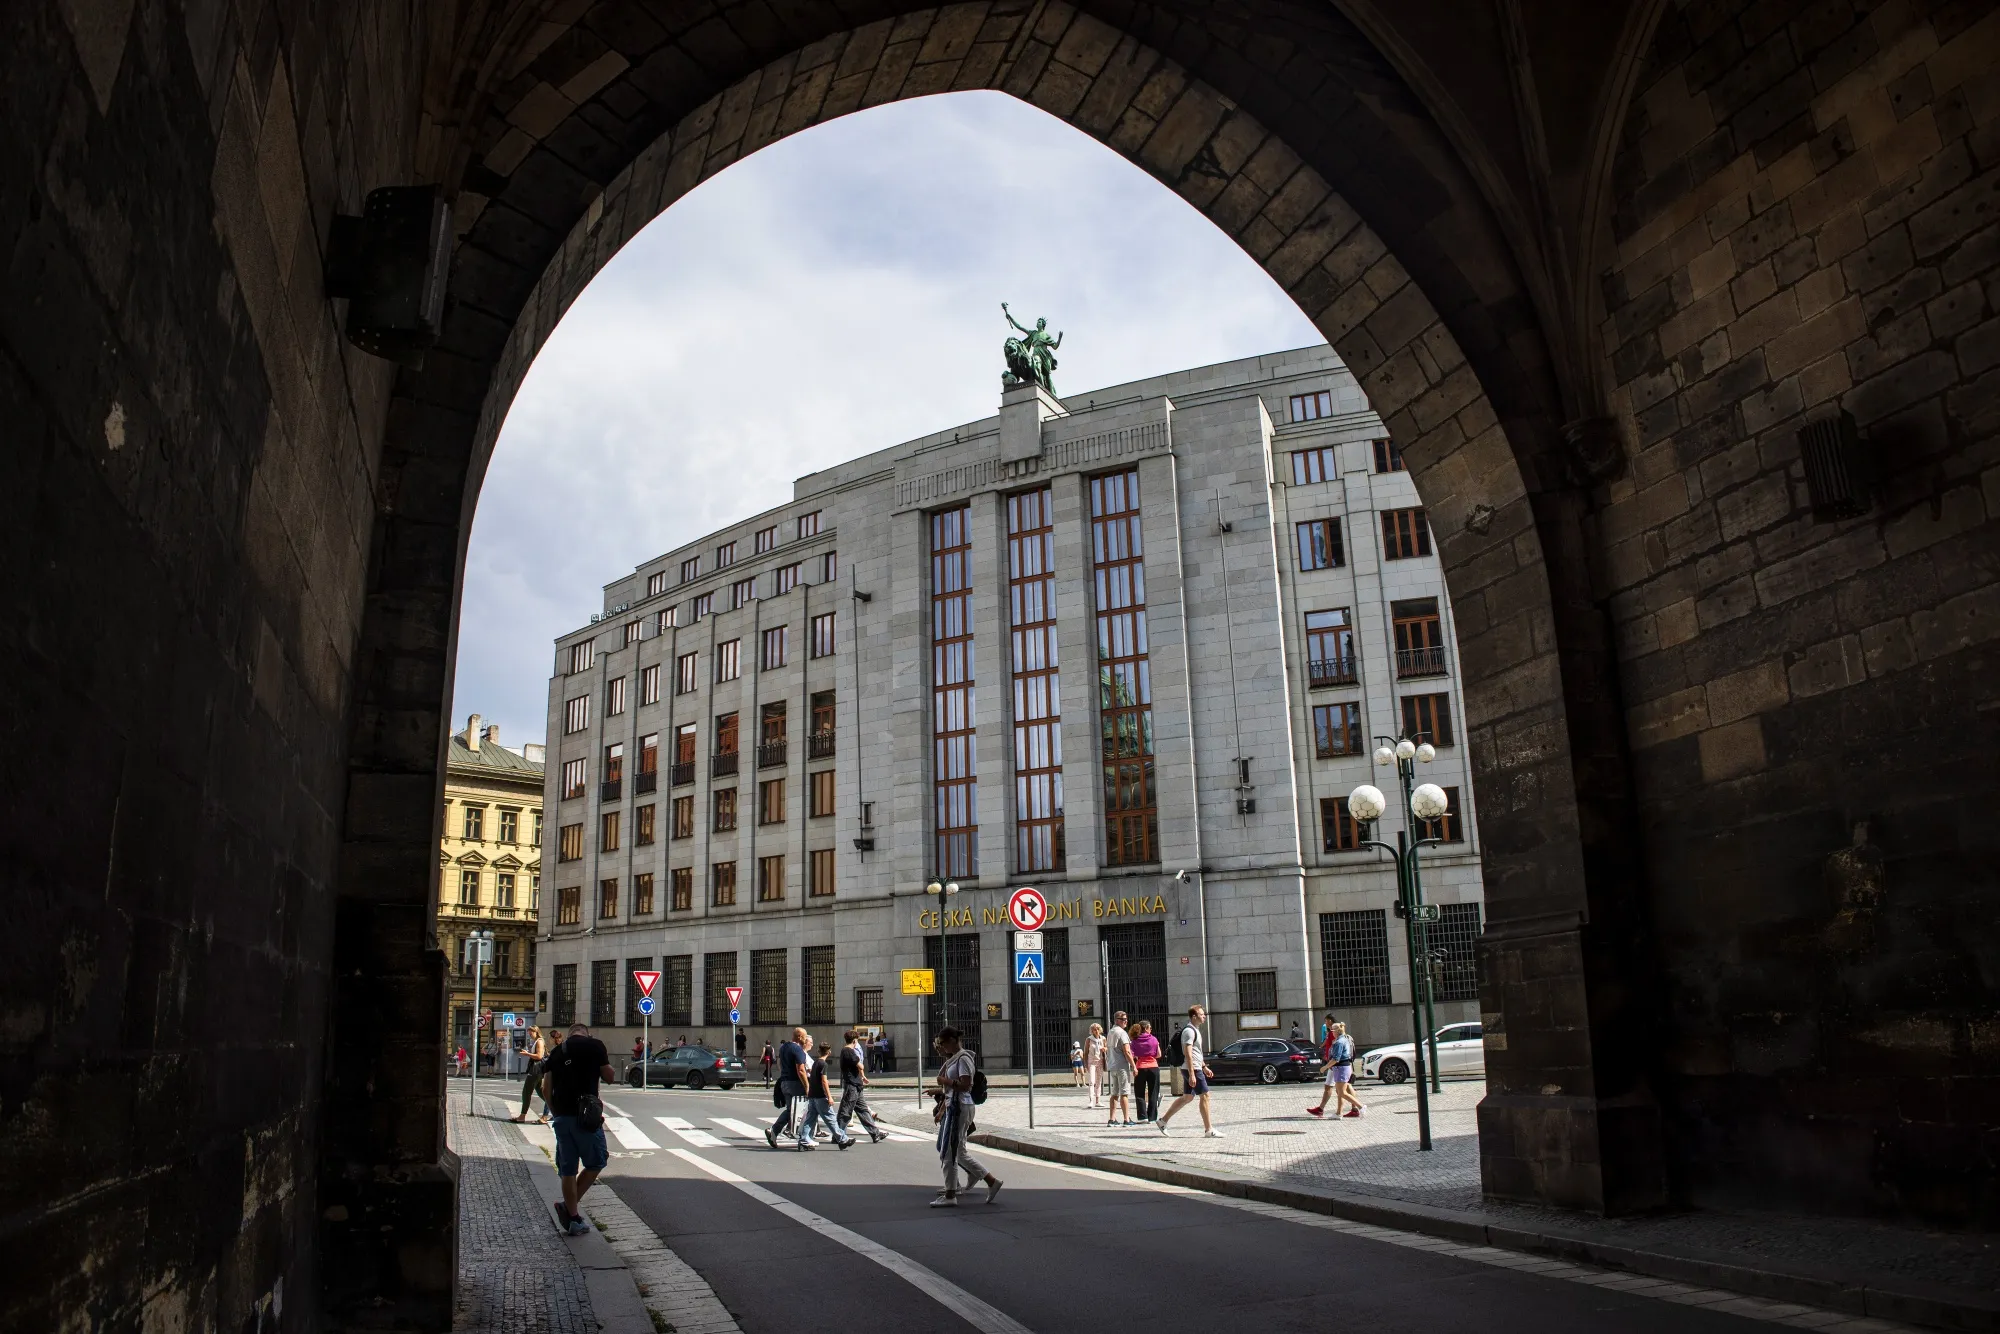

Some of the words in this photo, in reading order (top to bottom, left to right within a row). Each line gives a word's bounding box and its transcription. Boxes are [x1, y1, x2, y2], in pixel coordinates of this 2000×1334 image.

[919, 905, 974, 929] ČESKÁ
[983, 897, 1081, 925] NÁDNÍ
[1093, 895, 1167, 917] BANKA
[1419, 907, 1429, 917] WC
